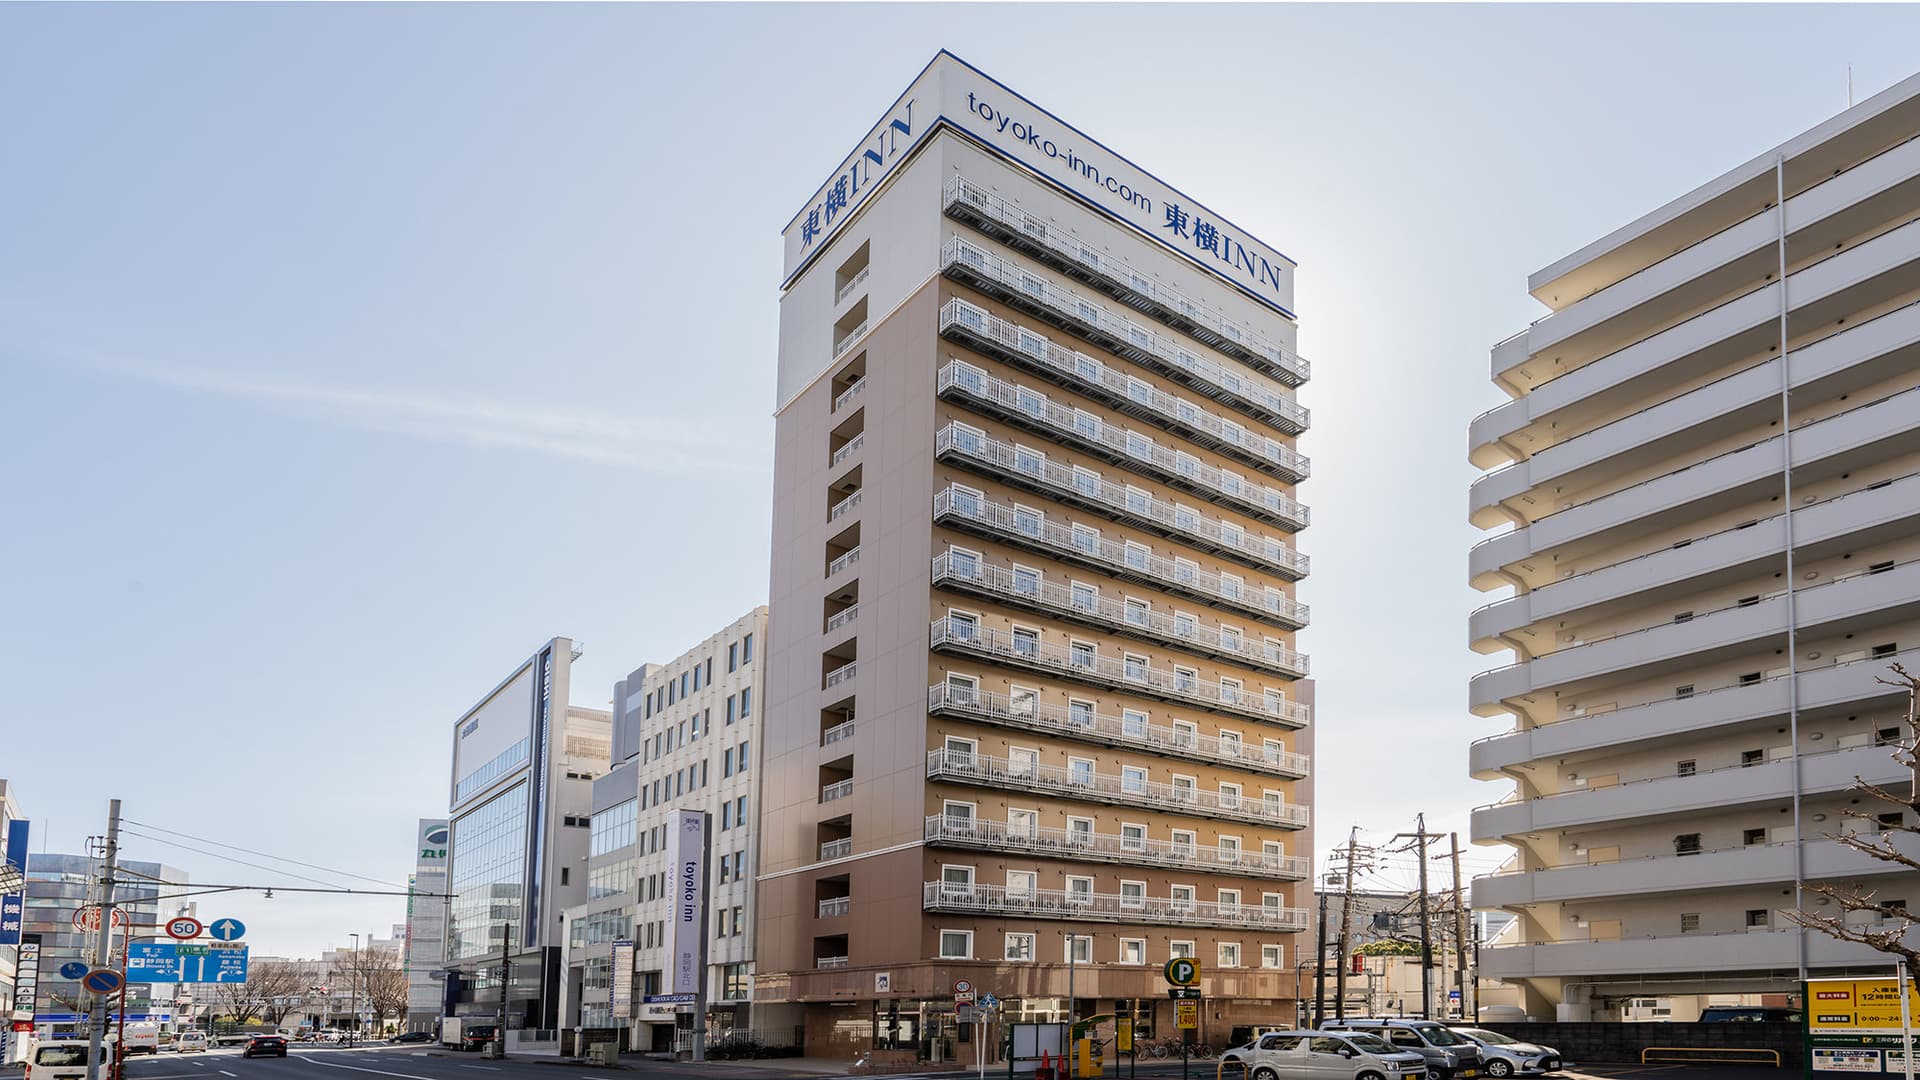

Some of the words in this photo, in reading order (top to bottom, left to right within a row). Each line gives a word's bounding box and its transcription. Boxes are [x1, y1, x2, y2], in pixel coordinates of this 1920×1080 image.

[800, 98, 915, 254] 東横INN
[968, 92, 1152, 214] toyoko-inn.com
[1162, 201, 1283, 293] 東横INN
[542, 660, 551, 701] OISHI
[683, 862, 697, 901] toyoko
[174, 923, 195, 934] 50
[684, 905, 696, 922] inn
[1178, 963, 1192, 981] P
